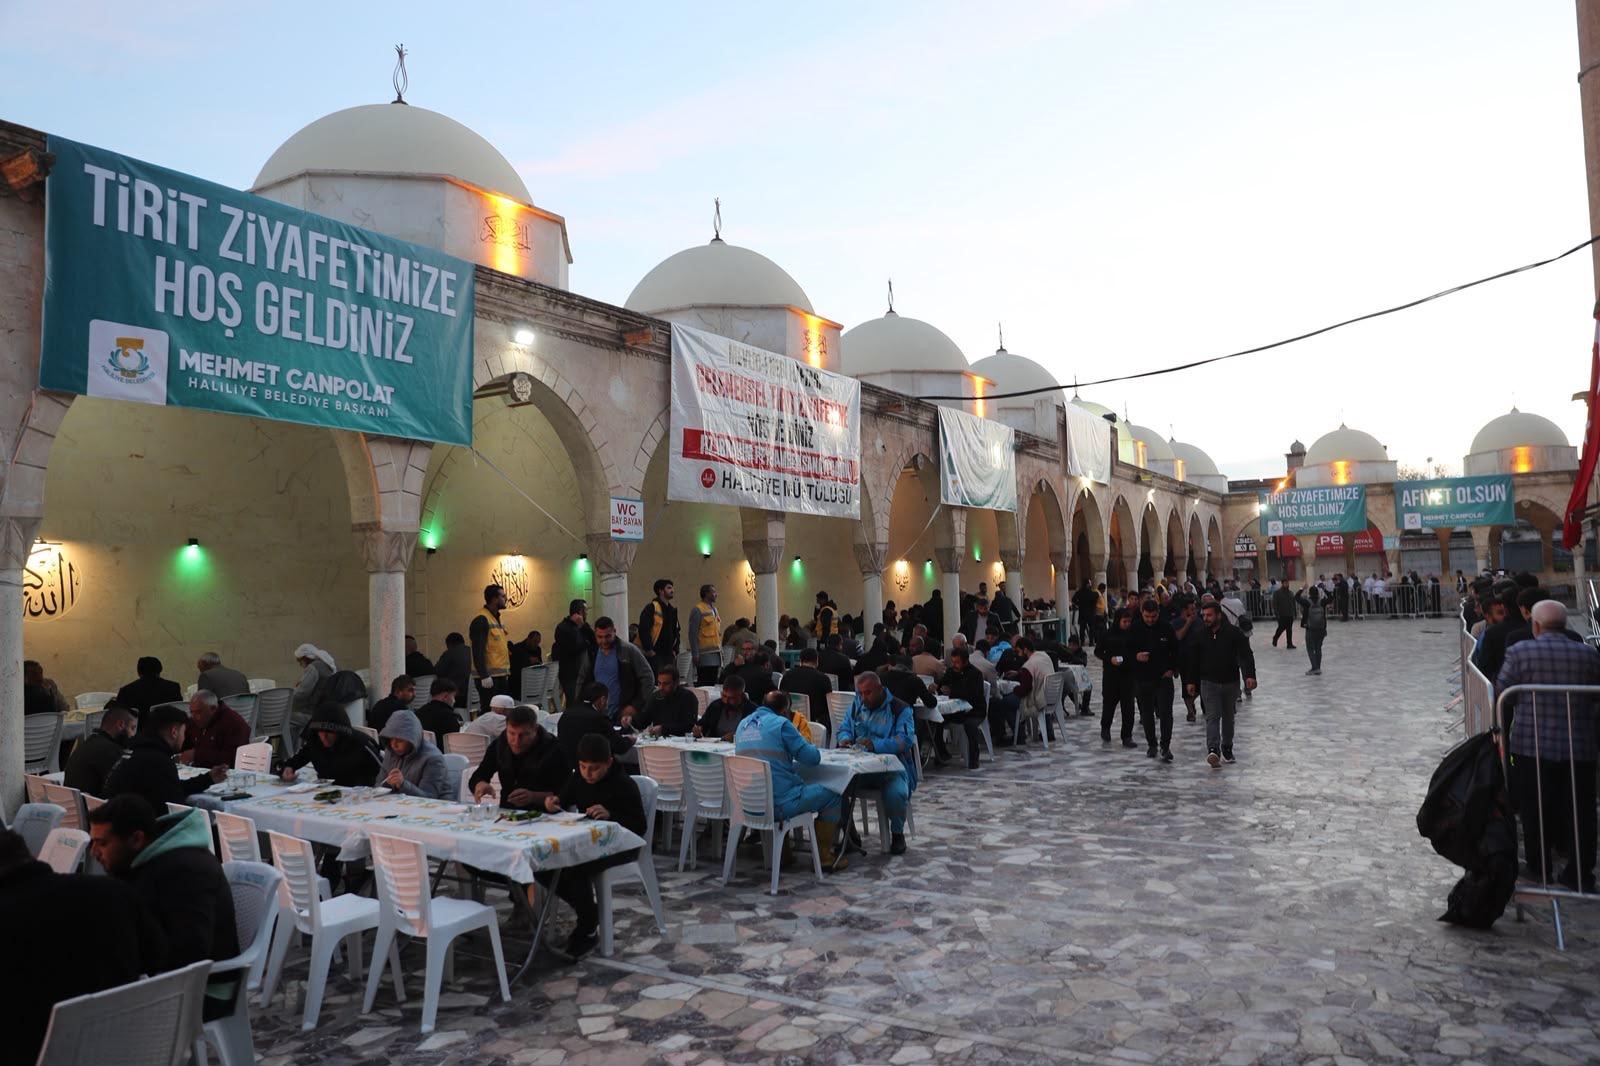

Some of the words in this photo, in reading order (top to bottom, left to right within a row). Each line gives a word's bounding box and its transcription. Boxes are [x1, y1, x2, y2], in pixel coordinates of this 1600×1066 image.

[84, 163, 208, 251] TİRİT
[218, 203, 457, 318] ZİYAFETİMİZE
[155, 255, 243, 338] HOŞ
[255, 280, 415, 365] GELDİNİZ
[179, 348, 280, 385] MEHMET
[286, 367, 395, 405] CANPOLAT
[335, 399, 390, 418] BAŞKANI
[1456, 483, 1507, 504] OLSUN
[617, 503, 636, 516] WC
[1278, 504, 1298, 519] HOŞ
[611, 515, 622, 525] BAY
[624, 516, 642, 527] BAYAN
